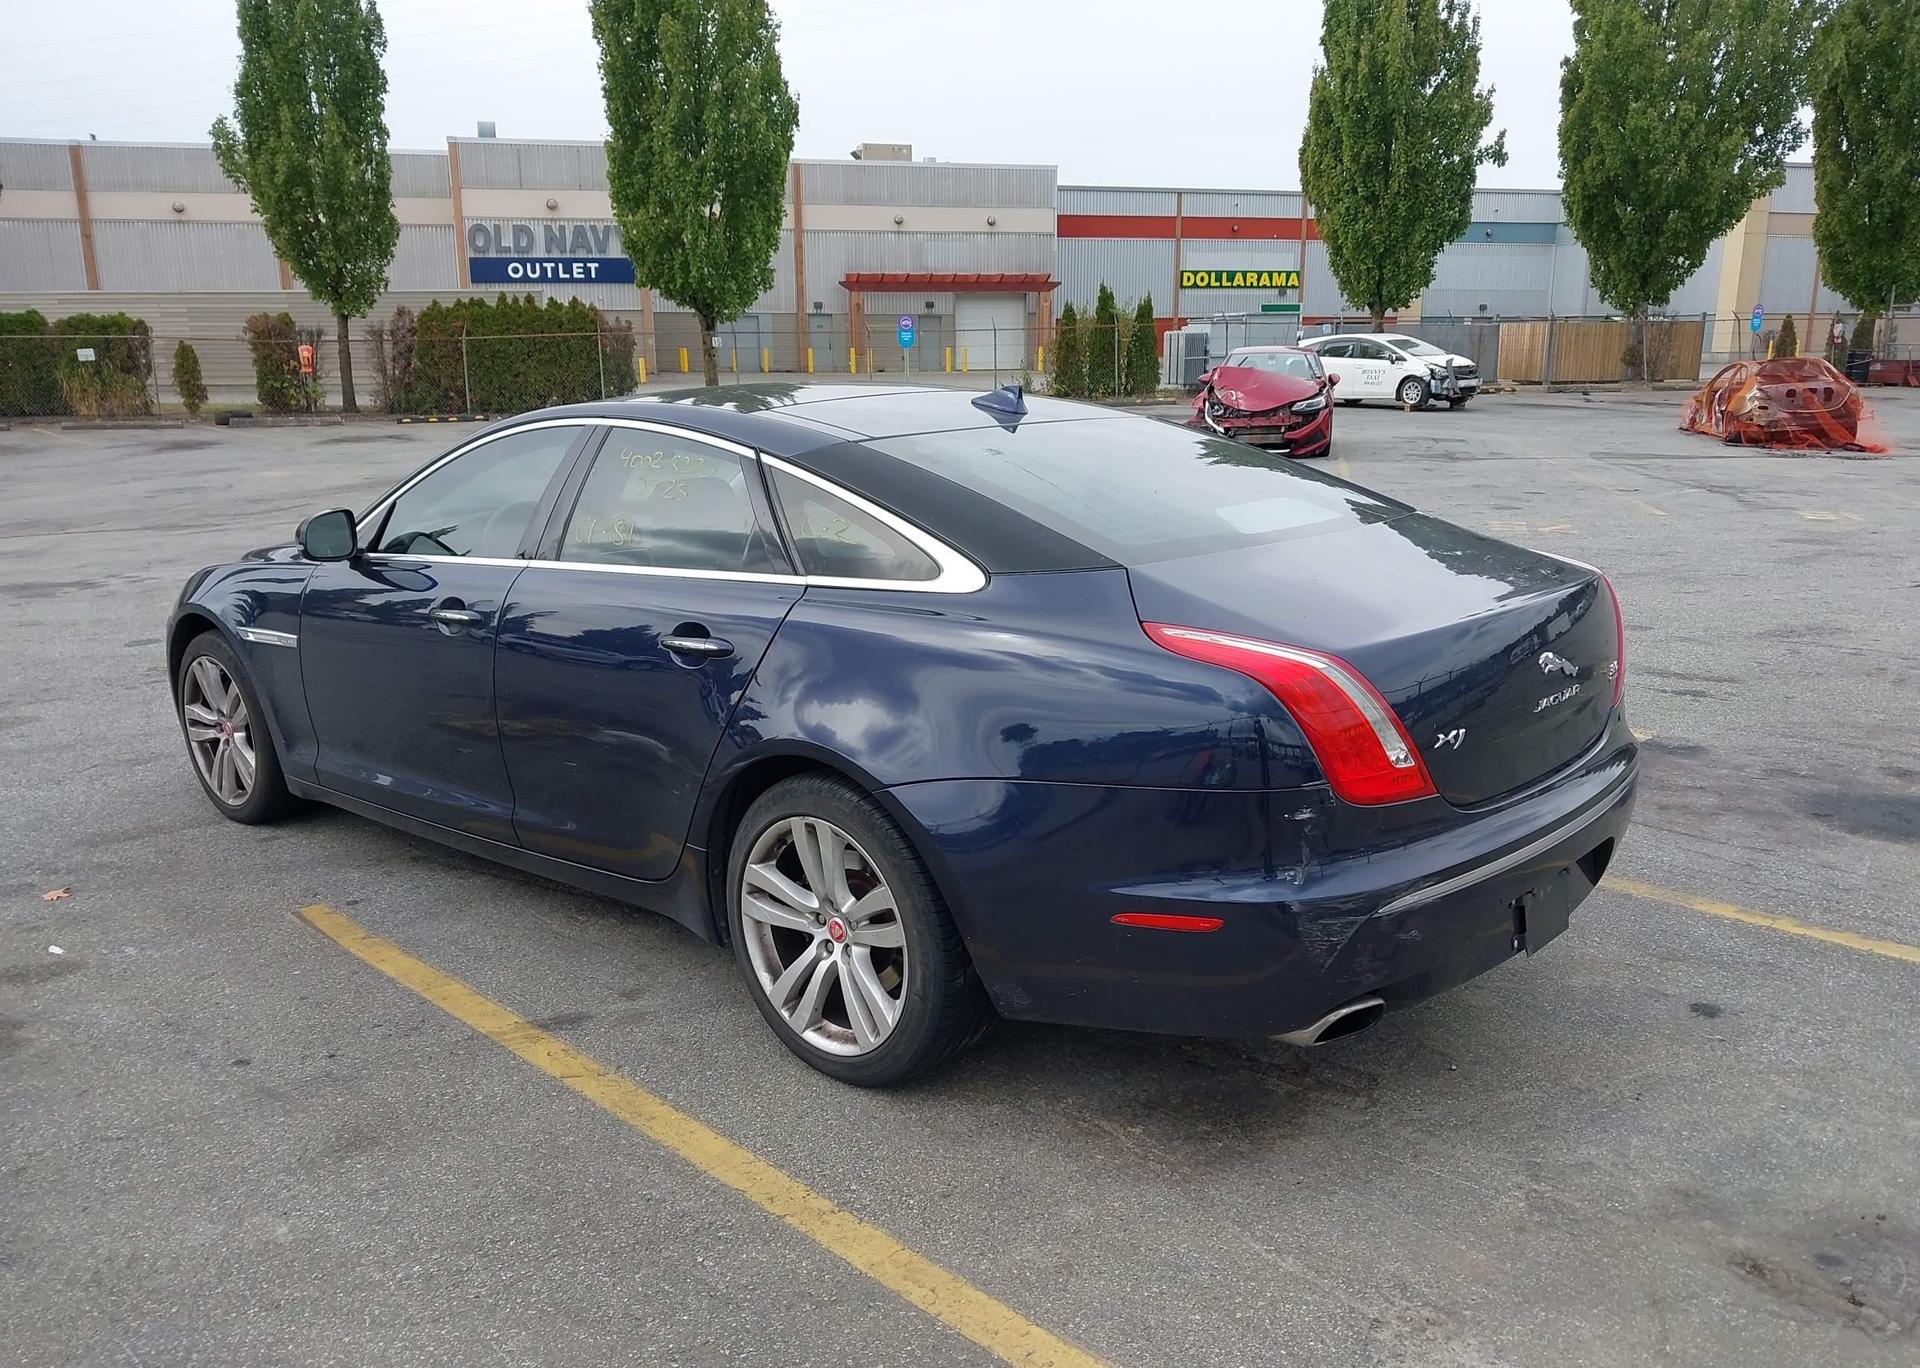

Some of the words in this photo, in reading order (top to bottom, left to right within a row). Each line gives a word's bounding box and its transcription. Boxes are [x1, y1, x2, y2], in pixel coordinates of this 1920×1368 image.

[467, 223, 535, 254] OLD
[507, 262, 600, 279] OUTLET
[1182, 271, 1300, 287] DOLLARAMA
[1533, 684, 1581, 713] JAGUAR
[1434, 728, 1467, 750] XJ
